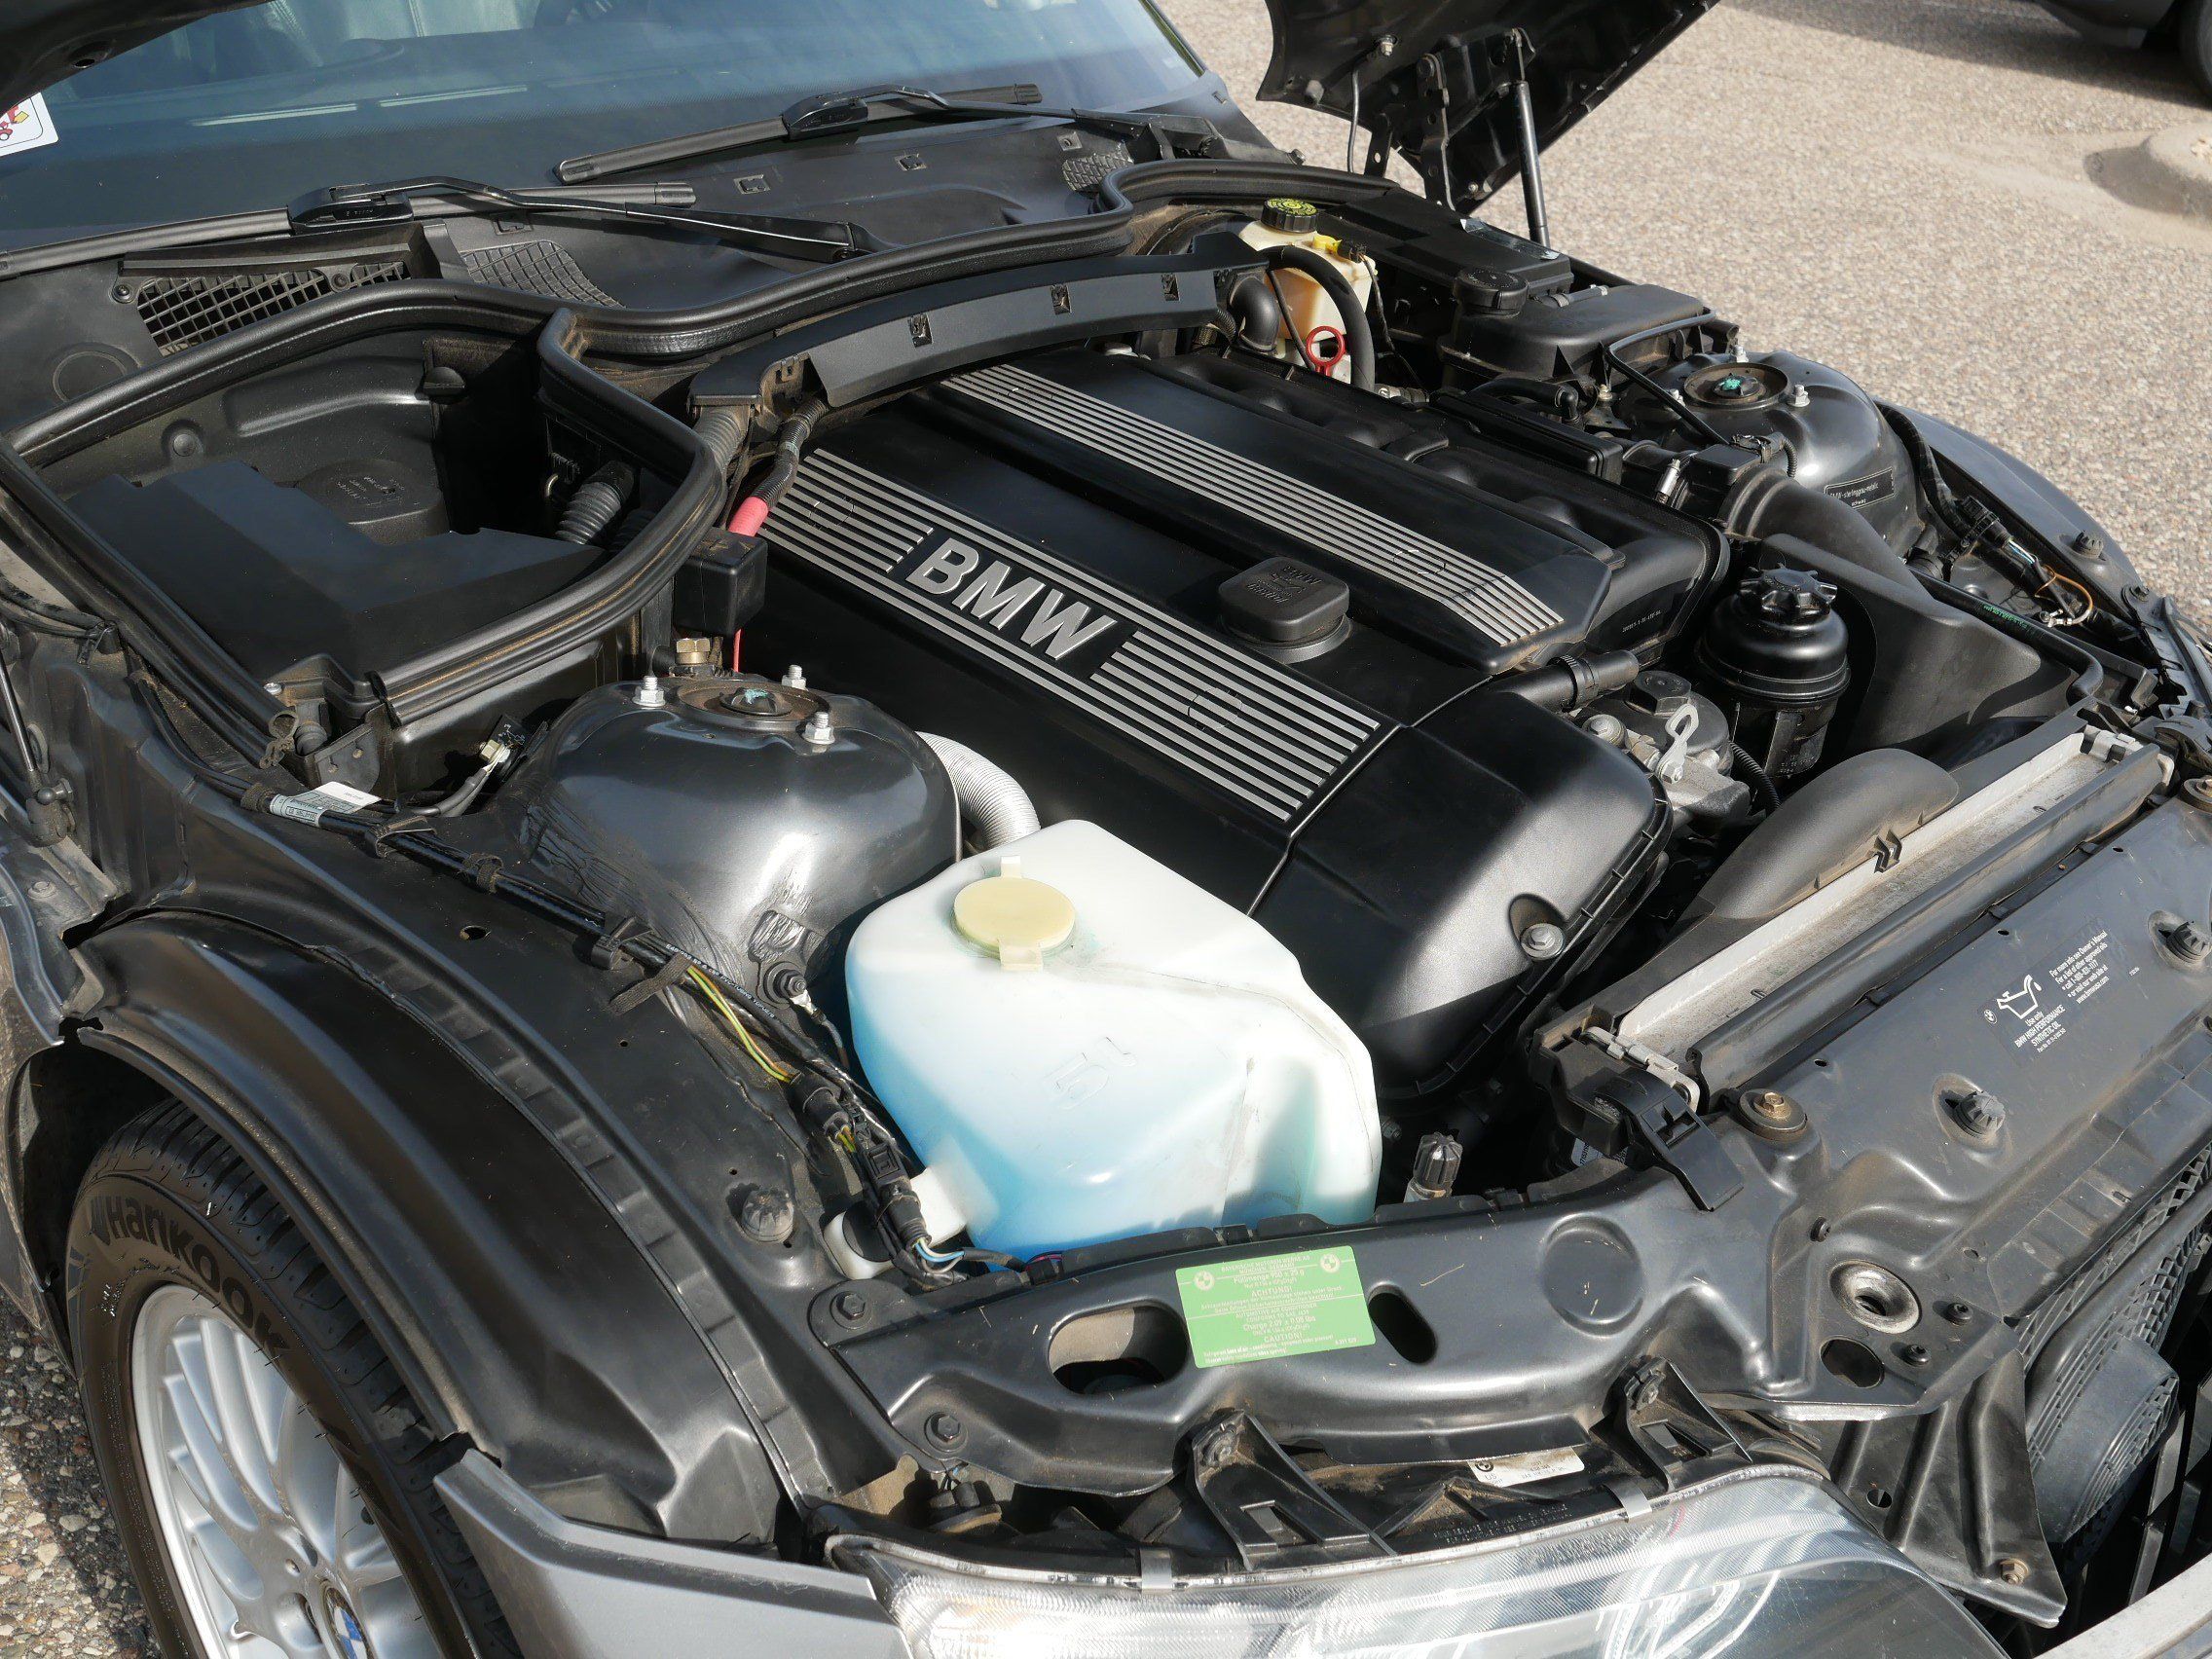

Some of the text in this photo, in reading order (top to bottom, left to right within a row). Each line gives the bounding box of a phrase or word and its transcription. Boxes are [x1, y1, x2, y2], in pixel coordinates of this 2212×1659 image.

[905, 537, 1118, 660] BMW
[2056, 961, 2067, 971] more
[2079, 940, 2095, 953] Owner's
[2093, 930, 2107, 942] Manual
[2055, 975, 2064, 984] For
[2074, 958, 2085, 969] other
[2083, 946, 2101, 962] approved
[2098, 941, 2107, 950] oils
[2064, 979, 2073, 988] call
[2075, 984, 2083, 992] visit
[2088, 972, 2097, 981] web
[2014, 1035, 2027, 1047] BMW
[2025, 1027, 2037, 1038] HIGH
[2034, 1004, 2065, 1030] PERFORMANCE
[2025, 1010, 2044, 1026] Use only
[2031, 1025, 2054, 1046] SYNTHETIC
[2051, 1019, 2061, 1029] OIL
[1221, 1263, 1254, 1271] BAYERISCHE
[1233, 1273, 1268, 1284] Füllmenge
[1251, 1285, 1292, 1297] ACHTUNG!
[1235, 1309, 1268, 1318] AUTOMOTIVE
[1281, 1302, 1317, 1312] CONDITIONER
[1243, 1322, 1267, 1332] Charge
[1264, 1332, 1301, 1343] CAUTION!
